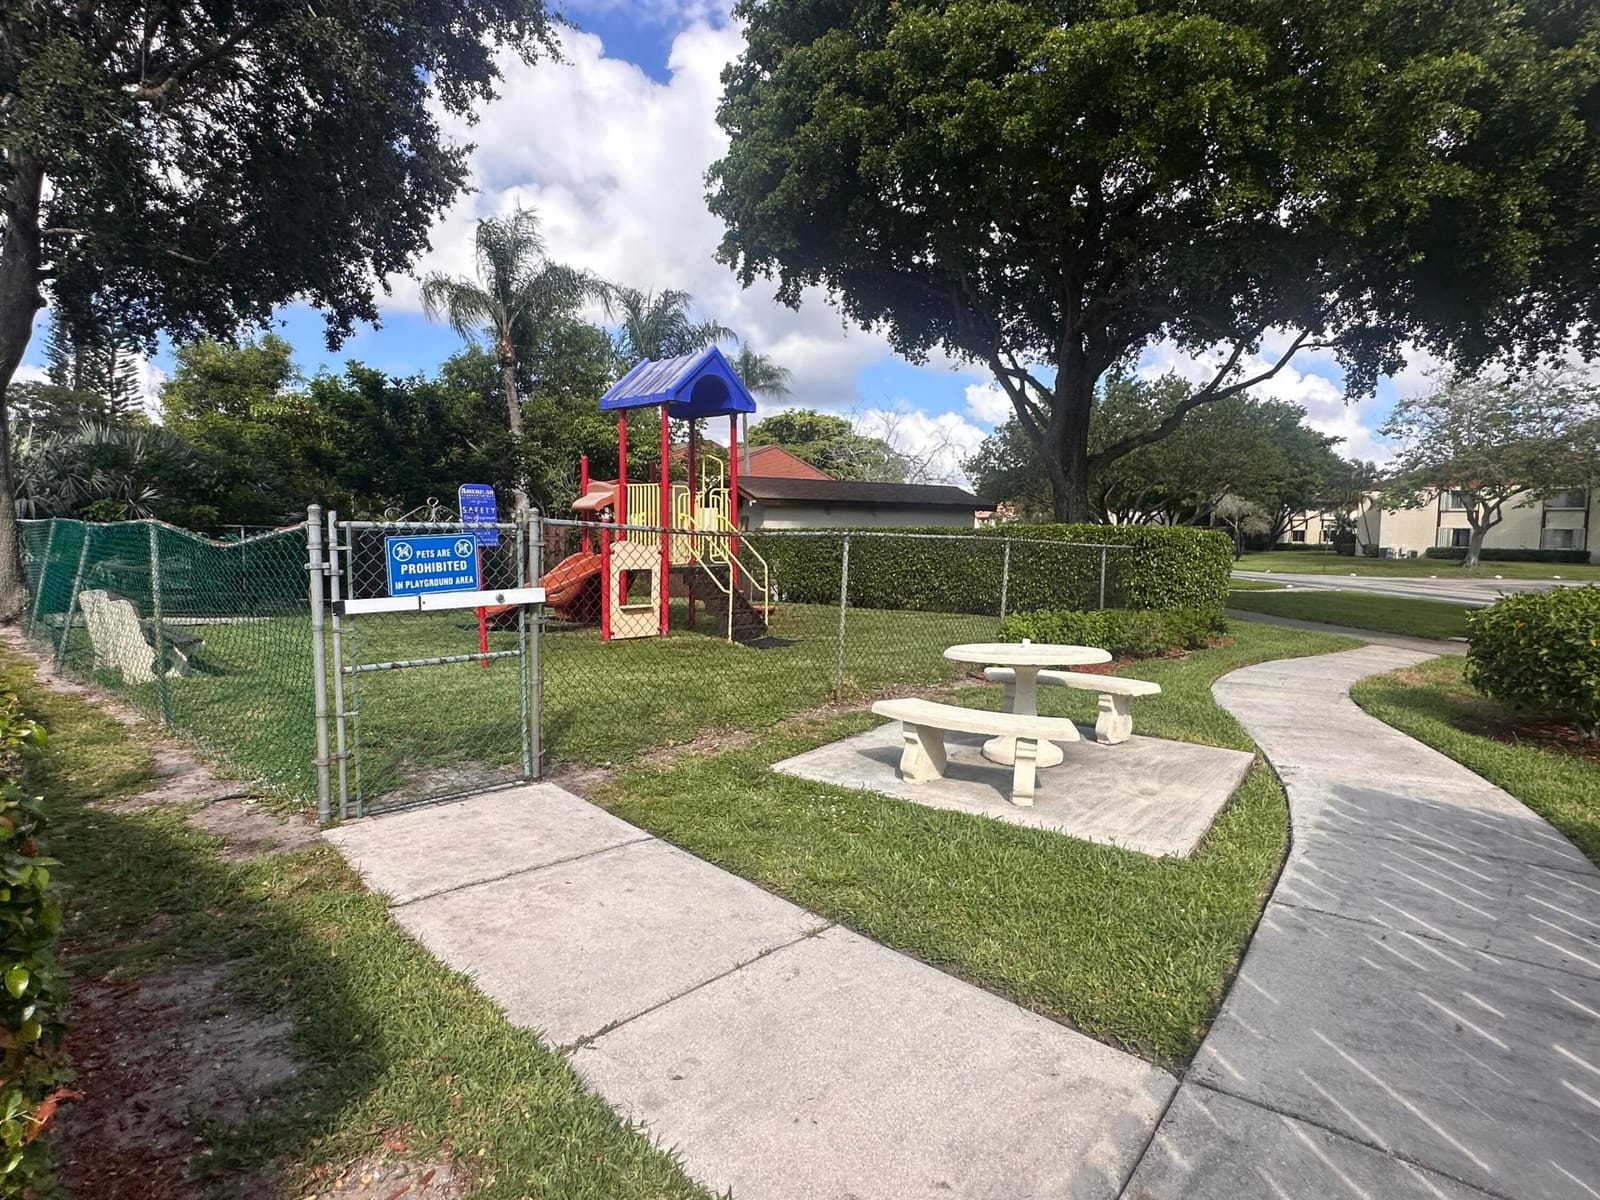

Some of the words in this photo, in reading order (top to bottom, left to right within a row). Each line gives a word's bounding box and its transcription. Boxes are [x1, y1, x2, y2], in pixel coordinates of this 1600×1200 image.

[462, 506, 496, 514] SAFETY
[416, 549, 435, 559] PETS
[436, 548, 451, 557] ARE
[400, 560, 468, 575] PROHIBITED
[395, 581, 404, 590] IN
[405, 577, 454, 589] PLAYGROUND
[455, 575, 474, 585] AREA
